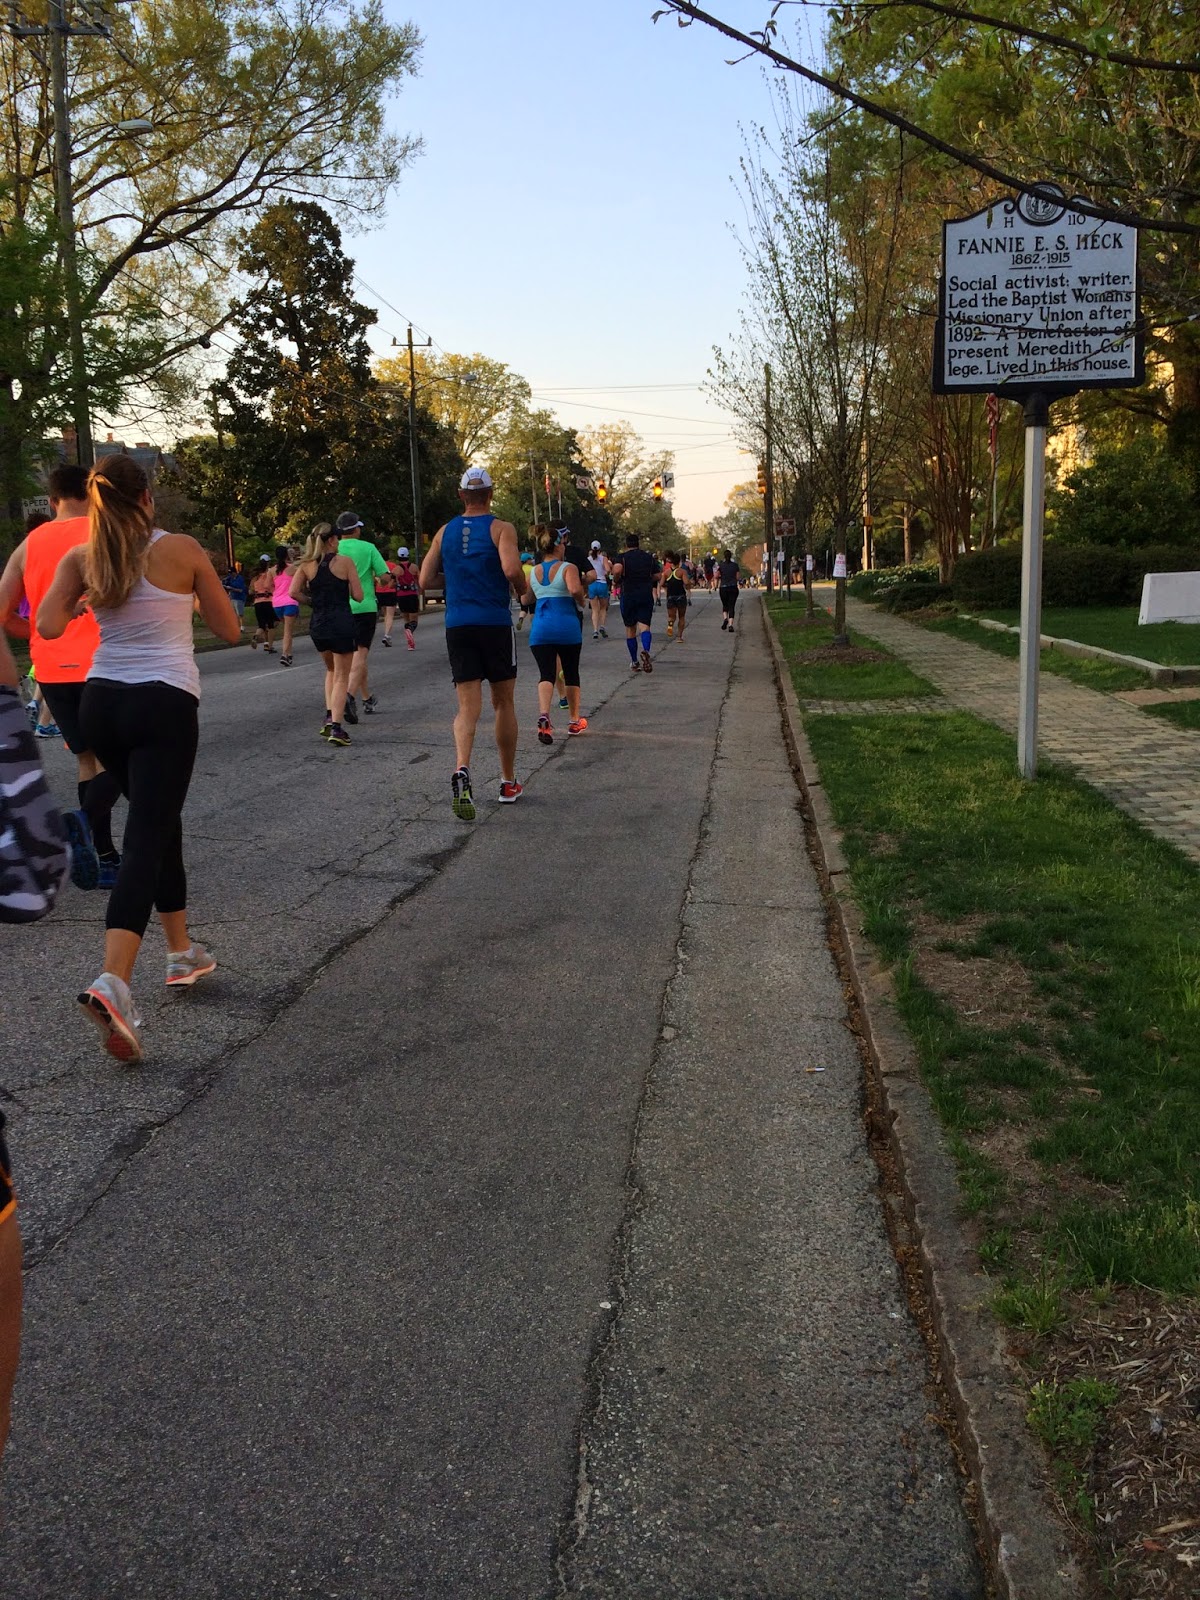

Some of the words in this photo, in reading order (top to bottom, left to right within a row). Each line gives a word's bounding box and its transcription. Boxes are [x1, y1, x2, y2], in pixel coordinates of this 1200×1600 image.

[1004, 217, 1014, 228] H
[1068, 214, 1086, 226] 110
[957, 236, 1025, 255] FANNIE
[1034, 236, 1049, 251] E.
[1055, 235, 1069, 251] S.
[1075, 233, 1124, 251] HECK
[1011, 252, 1070, 265] 1862-1915
[948, 274, 997, 291] Social
[1078, 271, 1133, 287] writer.
[948, 293, 978, 309] Led
[982, 292, 1007, 308] the
[1011, 289, 1067, 308] Baptist
[948, 310, 1033, 326] Missionary
[1039, 306, 1083, 322] Union
[1089, 305, 1132, 321] after
[949, 326, 986, 343] 1892.
[996, 326, 1009, 341] A
[1113, 321, 1131, 337] of
[948, 343, 1009, 360] present
[1017, 340, 1091, 356] Meredith
[1100, 338, 1131, 353] Col-
[948, 361, 983, 378] lege.
[986, 358, 1029, 375] Lived
[1033, 360, 1046, 373] in
[1050, 358, 1080, 372] this
[1083, 358, 1131, 372] house.
[23, 499, 49, 507] SPEED
[27, 507, 47, 515] LIMIT
